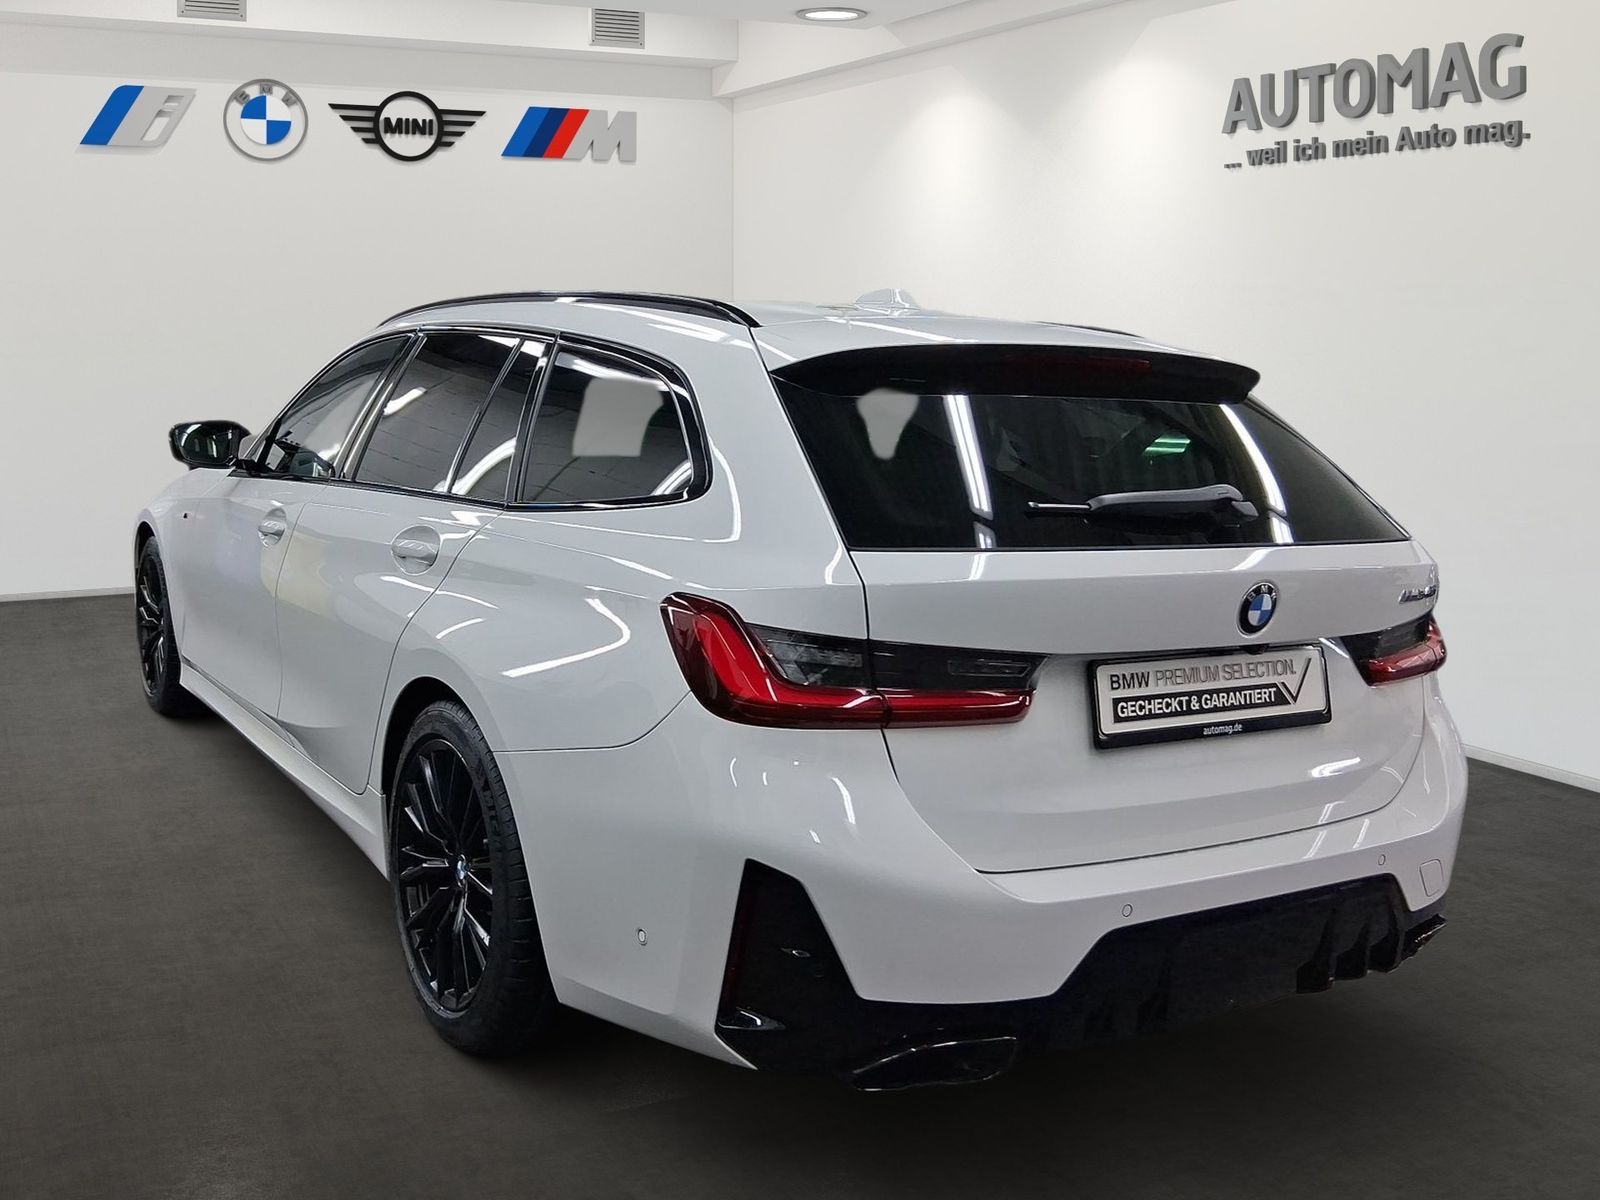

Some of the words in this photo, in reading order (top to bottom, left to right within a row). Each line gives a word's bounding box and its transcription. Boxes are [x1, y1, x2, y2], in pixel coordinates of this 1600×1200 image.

[1222, 33, 1527, 134] AUTOMAG
[384, 116, 433, 136] MINI
[562, 104, 638, 162] M
[1246, 140, 1288, 166] weil
[1293, 136, 1327, 162] ich
[1332, 130, 1389, 158] mein
[1395, 123, 1457, 151] Auto
[1464, 119, 1531, 148] mag.
[1110, 670, 1150, 691] BMW
[1155, 665, 1221, 687] PREMIUM
[1117, 696, 1189, 718] GECHECKT
[1190, 695, 1200, 710] &
[1201, 687, 1277, 709] GARANTIERT
[1203, 722, 1243, 736] automag.de
